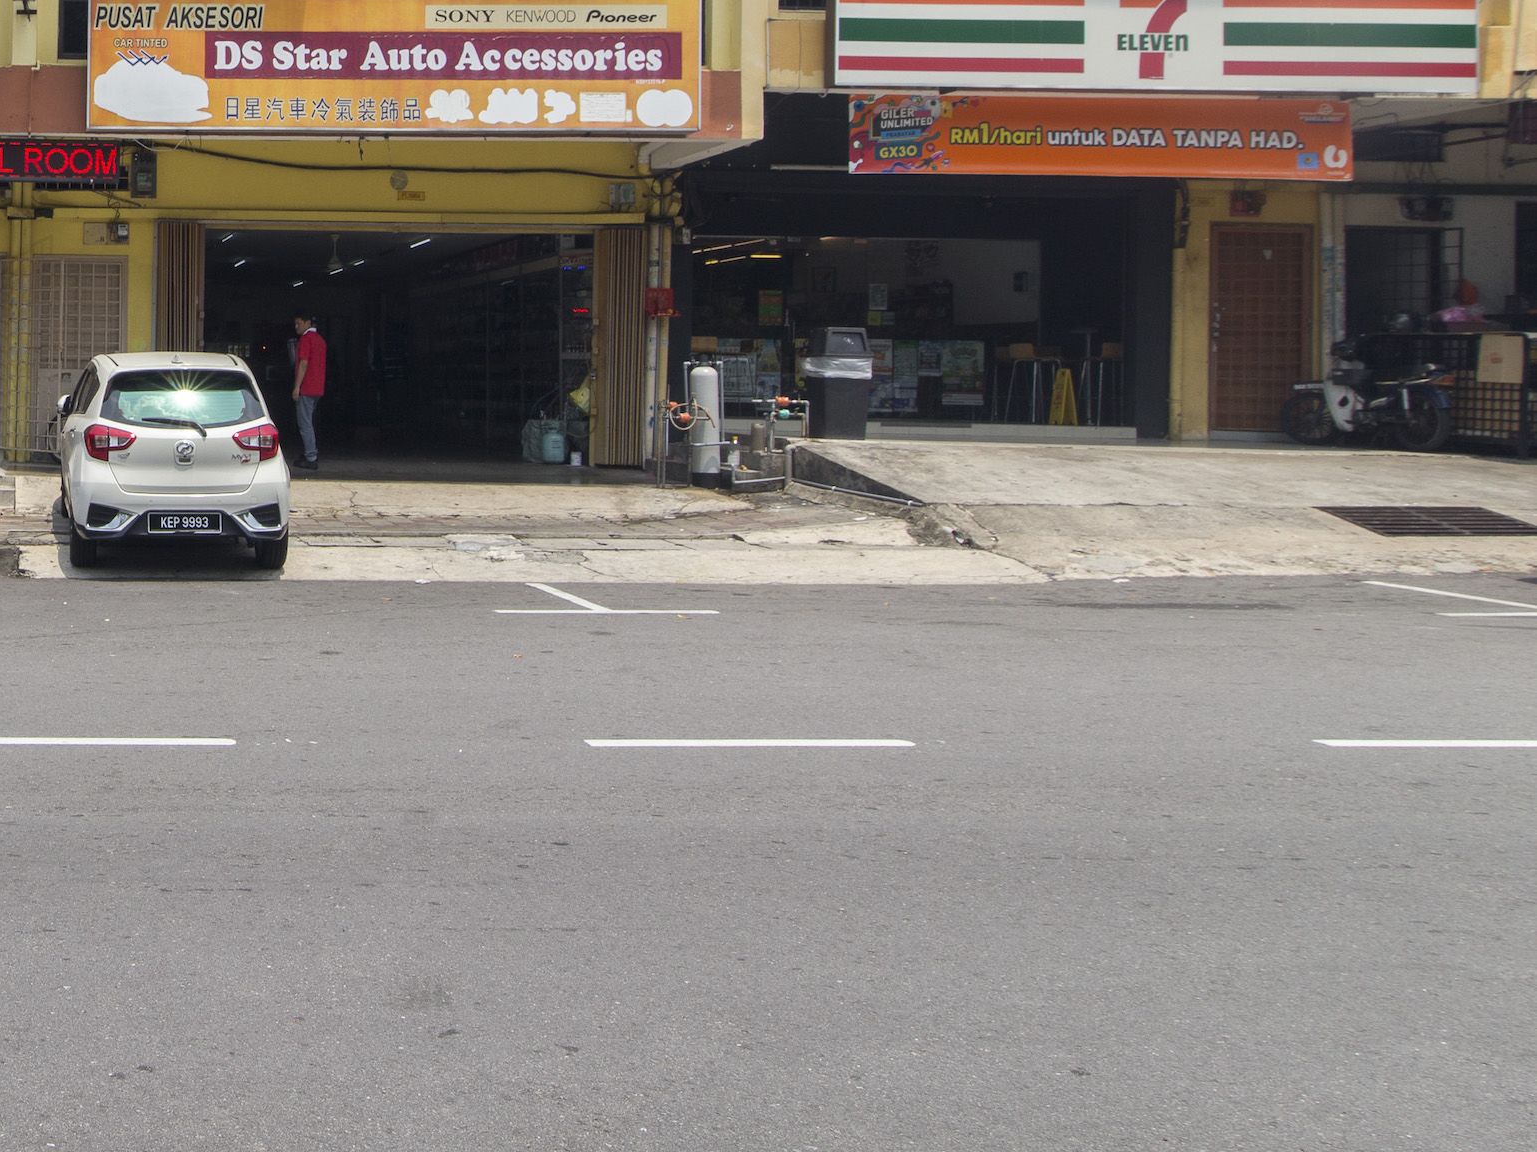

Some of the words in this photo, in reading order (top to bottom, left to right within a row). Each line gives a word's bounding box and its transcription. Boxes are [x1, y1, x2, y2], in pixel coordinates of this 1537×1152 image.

[94, 5, 157, 29] PUSAT
[165, 5, 263, 29] AKSESORI
[435, 9, 495, 23] SONY
[506, 9, 576, 23] KENWOOD
[586, 10, 657, 23] Pioneer
[113, 38, 134, 48] CAR
[135, 38, 168, 48] TINTED
[214, 40, 263, 70] DS
[272, 40, 348, 70] Star
[359, 40, 447, 71] Auto
[455, 41, 663, 71] Accessories
[881, 108, 914, 120] GILER
[880, 117, 933, 129] UNLIMITED
[949, 123, 1042, 145] RM1/hari
[1047, 128, 1106, 145] untuk
[1112, 129, 1167, 147] DATA
[1173, 130, 1244, 148] TANPA
[1250, 131, 1304, 149] HAD.
[879, 145, 918, 159] GX30
[24, 147, 117, 175] ROOM
[161, 517, 182, 528] KEP
[182, 517, 209, 529] 9993
